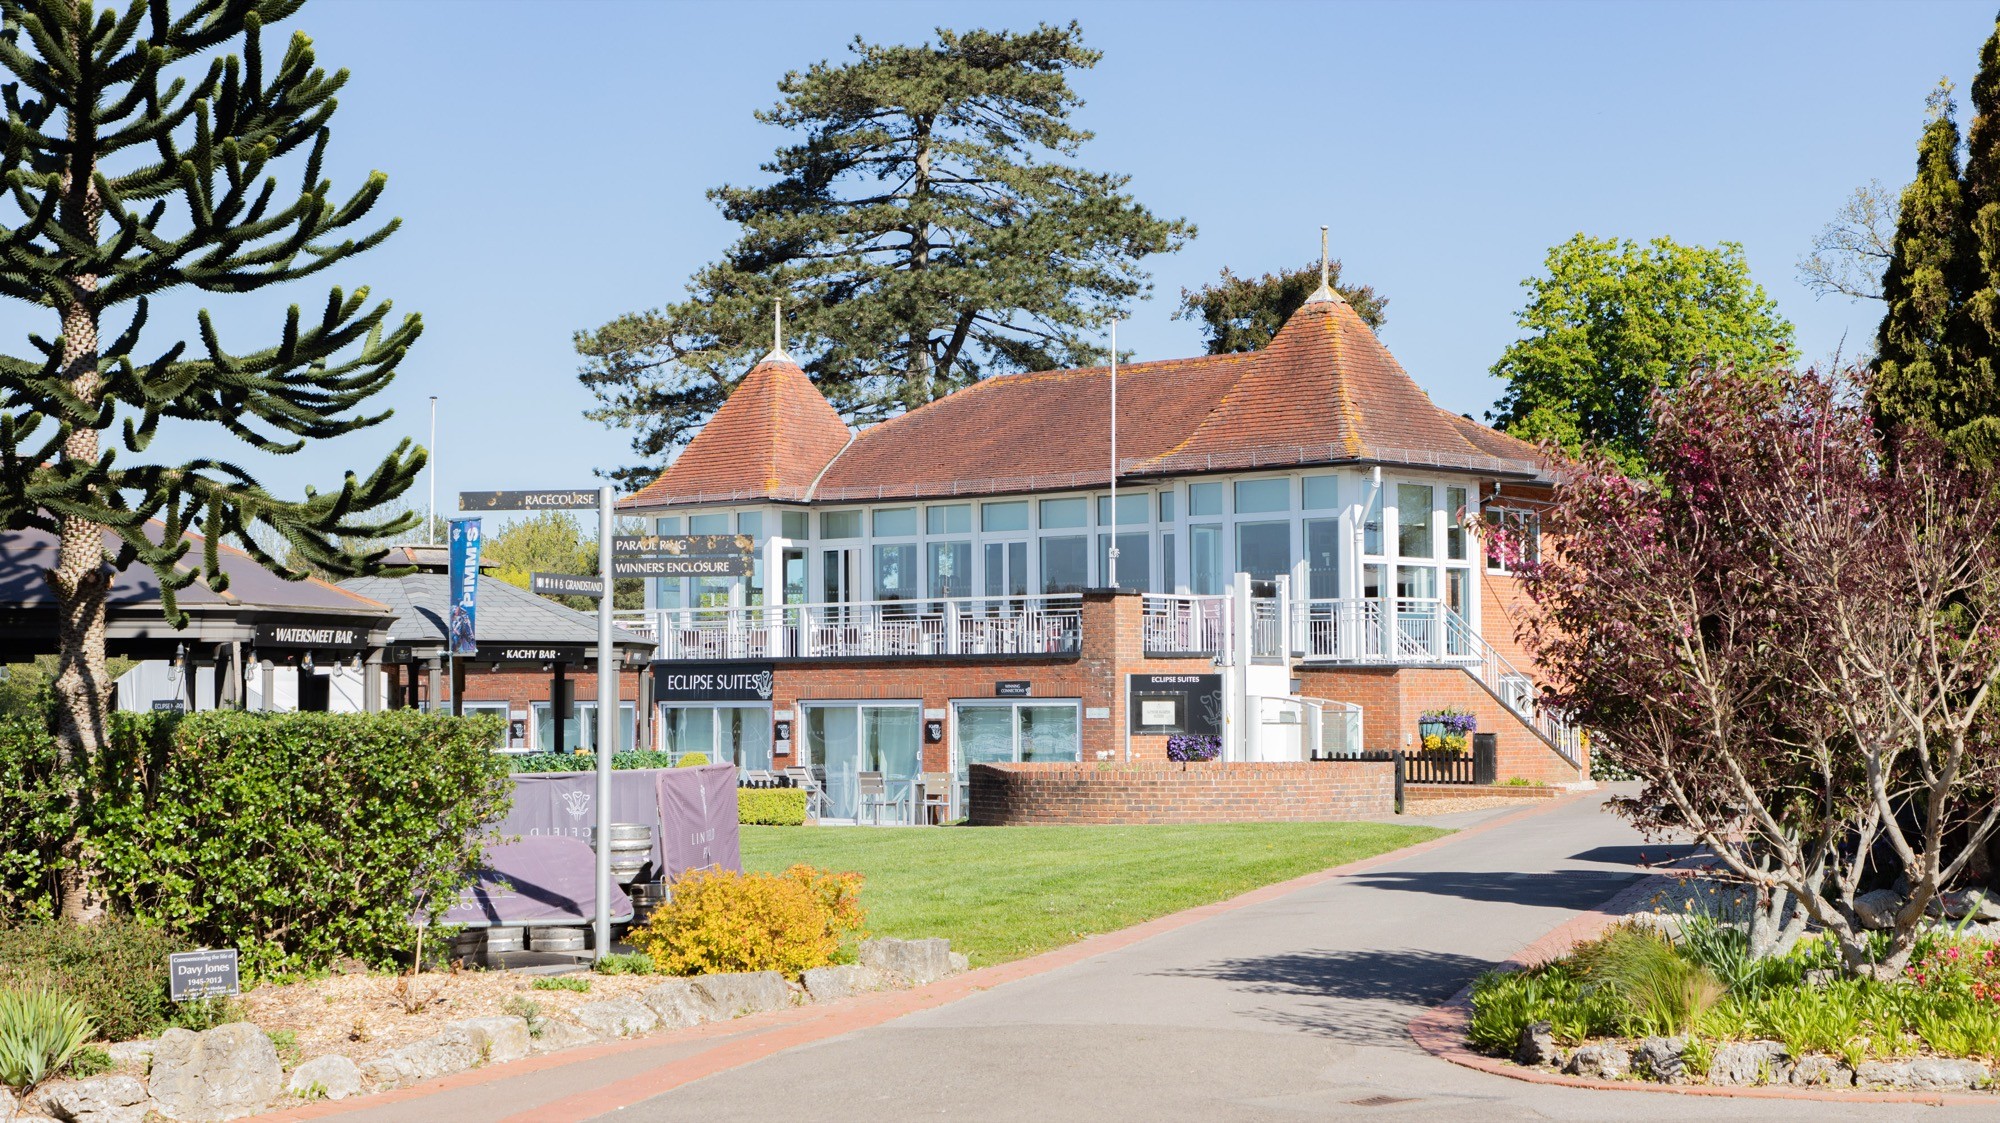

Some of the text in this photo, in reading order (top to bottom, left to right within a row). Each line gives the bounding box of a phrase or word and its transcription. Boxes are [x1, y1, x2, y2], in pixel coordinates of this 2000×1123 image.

[525, 494, 595, 505] RACECOURSE
[463, 526, 479, 608] PIMM'S
[616, 562, 730, 573] WINNERS ENCLOSURE
[565, 579, 603, 592] GRANDSTAND
[276, 628, 353, 644] WATERSMEET BAR
[506, 649, 556, 659] KACHY BAR
[668, 674, 759, 690] ECLIPSE SUITES
[178, 964, 230, 976] Davy Jones
